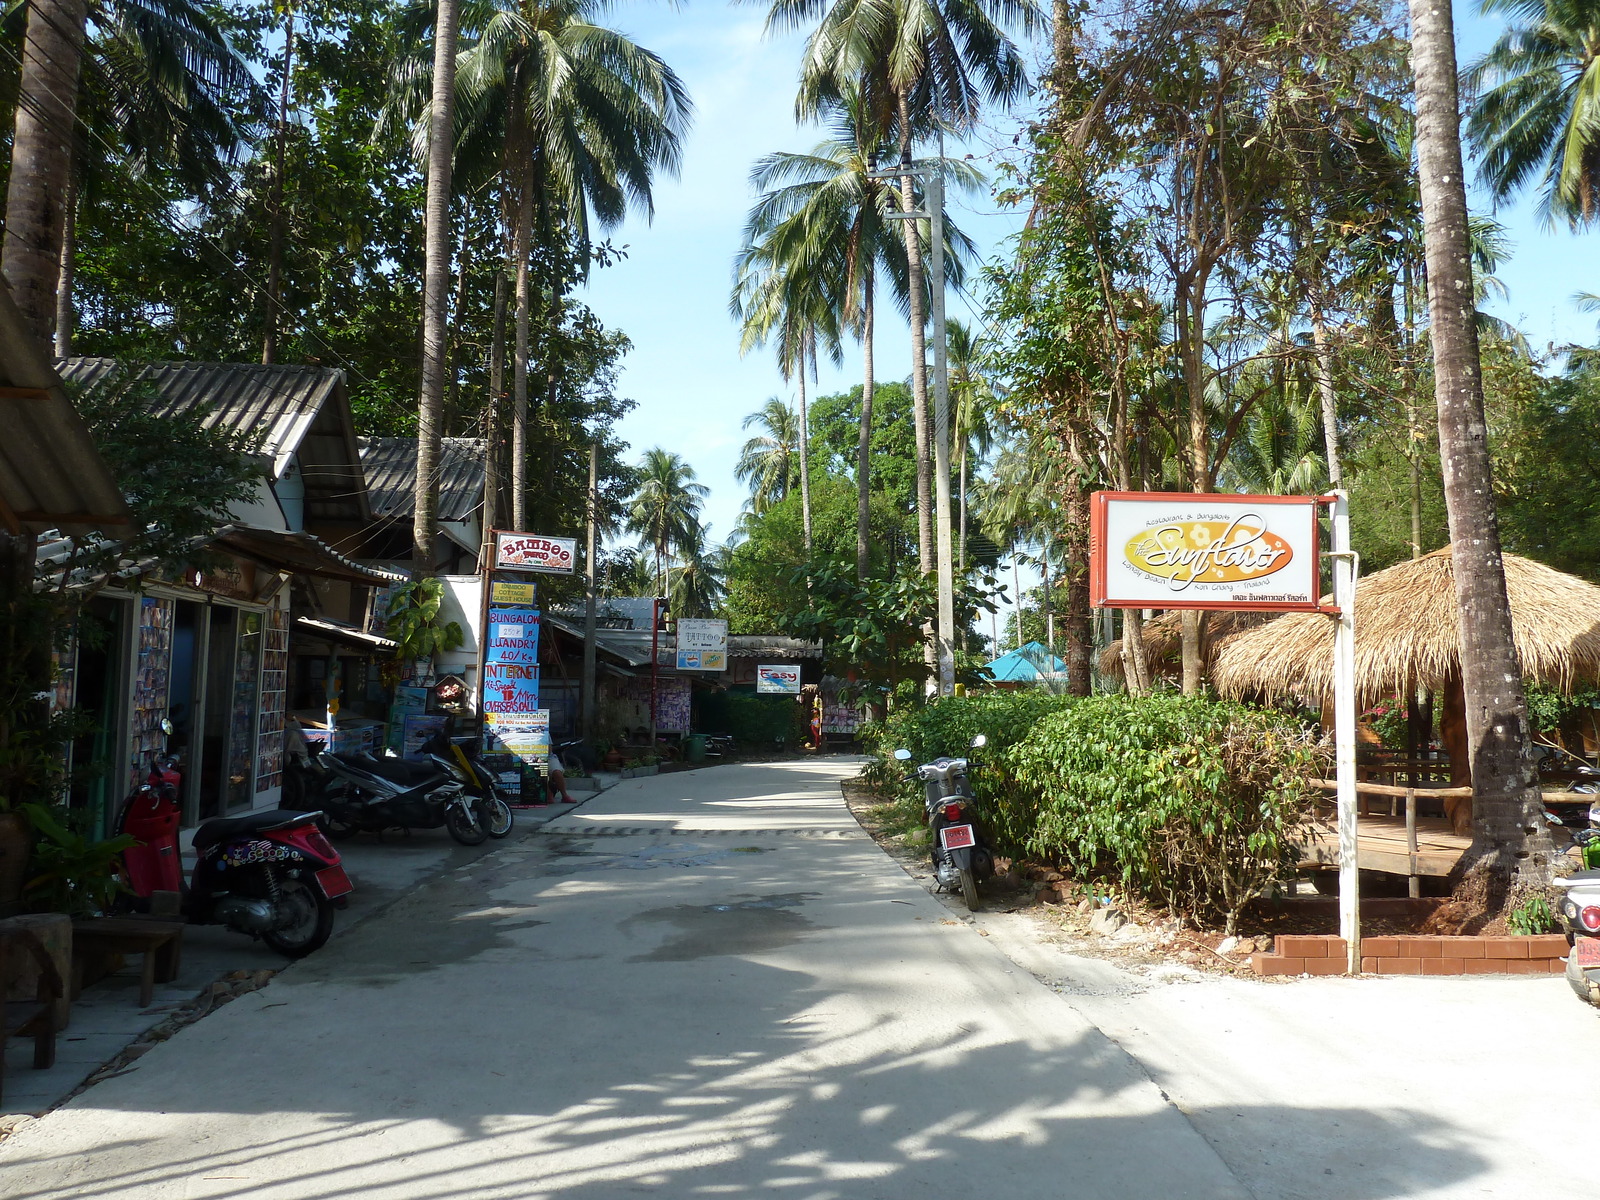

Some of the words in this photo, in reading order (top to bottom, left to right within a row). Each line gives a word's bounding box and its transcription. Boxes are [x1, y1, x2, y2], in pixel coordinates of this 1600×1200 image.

[1145, 514, 1183, 527] Restaurant
[503, 539, 570, 561] BAMBOO
[1146, 511, 1286, 591] Sunflower
[1122, 560, 1143, 577] Lonely
[1144, 574, 1166, 584] Beach
[1211, 584, 1234, 592] Chang
[1243, 578, 1271, 589] Thailand
[490, 612, 540, 624] BUNGALOW
[490, 637, 536, 650] LUANDRY
[685, 632, 720, 642] TATTOO
[485, 664, 539, 679] INTERNET
[760, 668, 797, 682] Easy
[484, 701, 518, 713] OVERSEAS
[518, 701, 536, 712] CALL
[248, 848, 290, 861] SCOOPY
